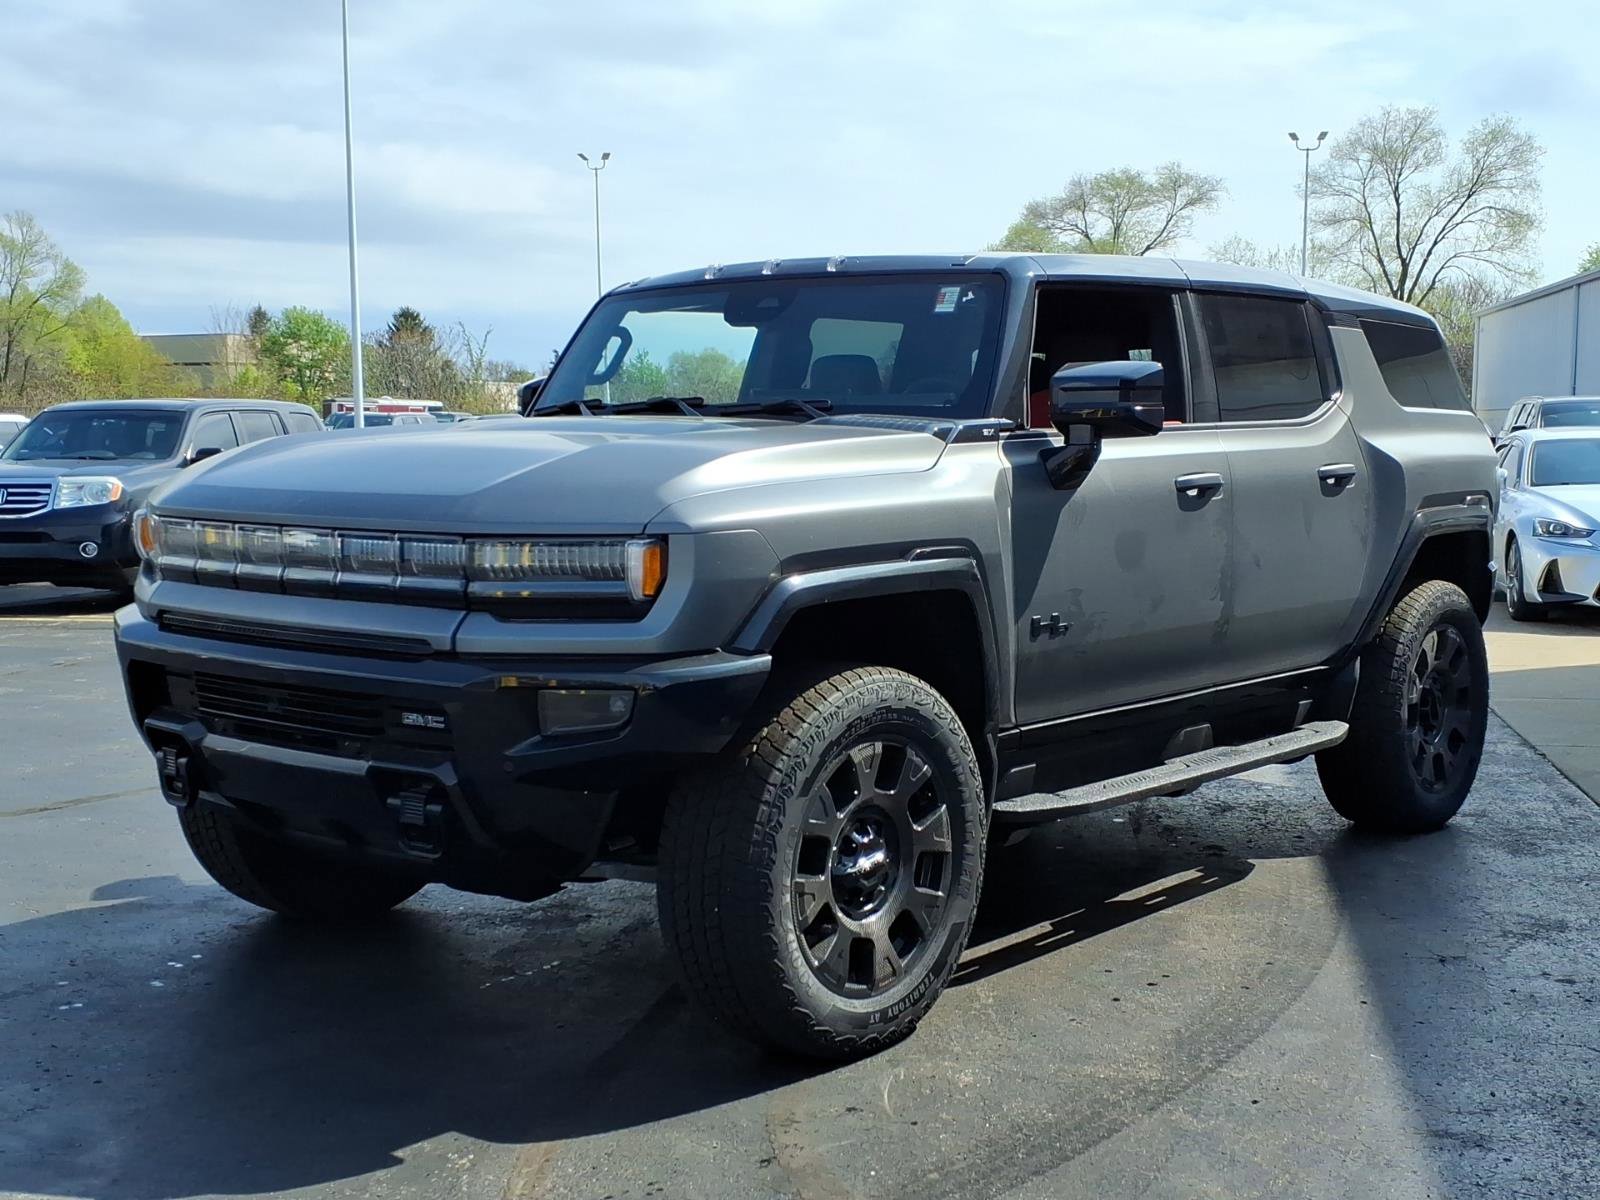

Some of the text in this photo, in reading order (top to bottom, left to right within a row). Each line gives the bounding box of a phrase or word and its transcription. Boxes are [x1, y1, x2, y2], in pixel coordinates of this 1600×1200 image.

[401, 712, 446, 729] GMC
[869, 972, 937, 1024] TERRITORY AT
